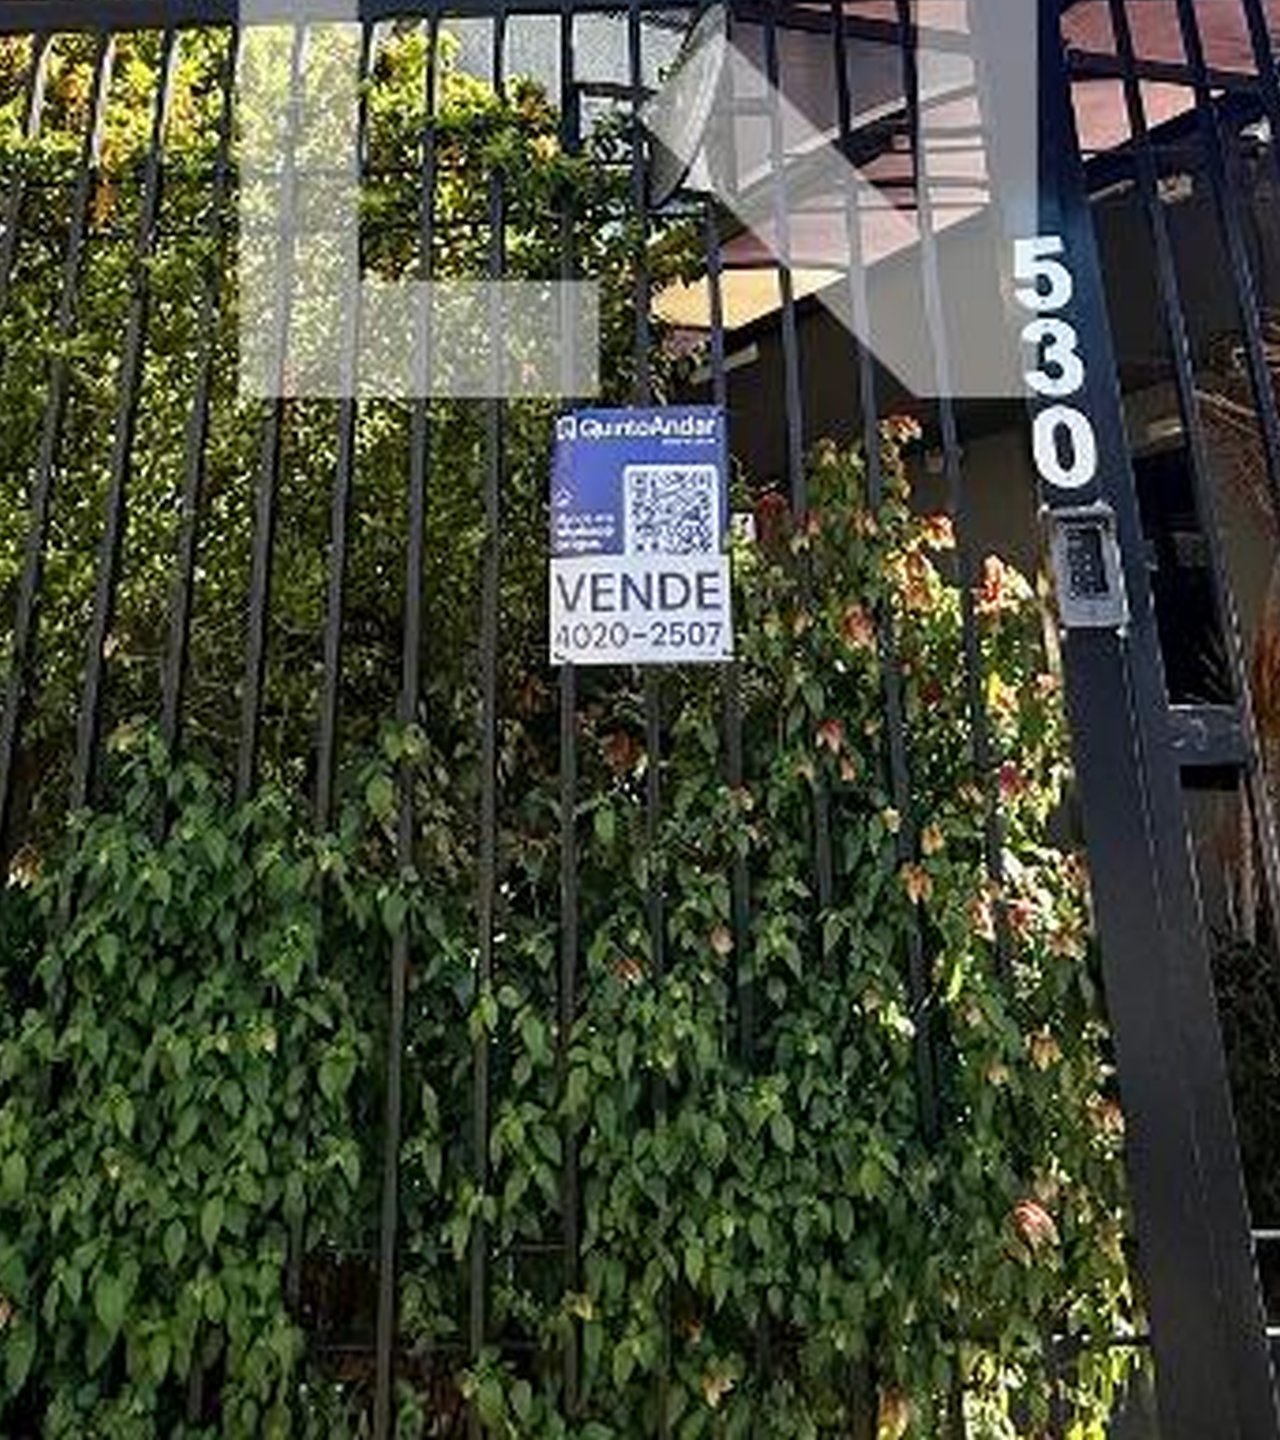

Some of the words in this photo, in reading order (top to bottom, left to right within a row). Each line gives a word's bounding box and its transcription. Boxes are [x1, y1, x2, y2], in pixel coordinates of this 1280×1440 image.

[1013, 235, 1098, 489] 530
[556, 571, 721, 613] VENDE
[555, 622, 723, 650] 4020-2507
